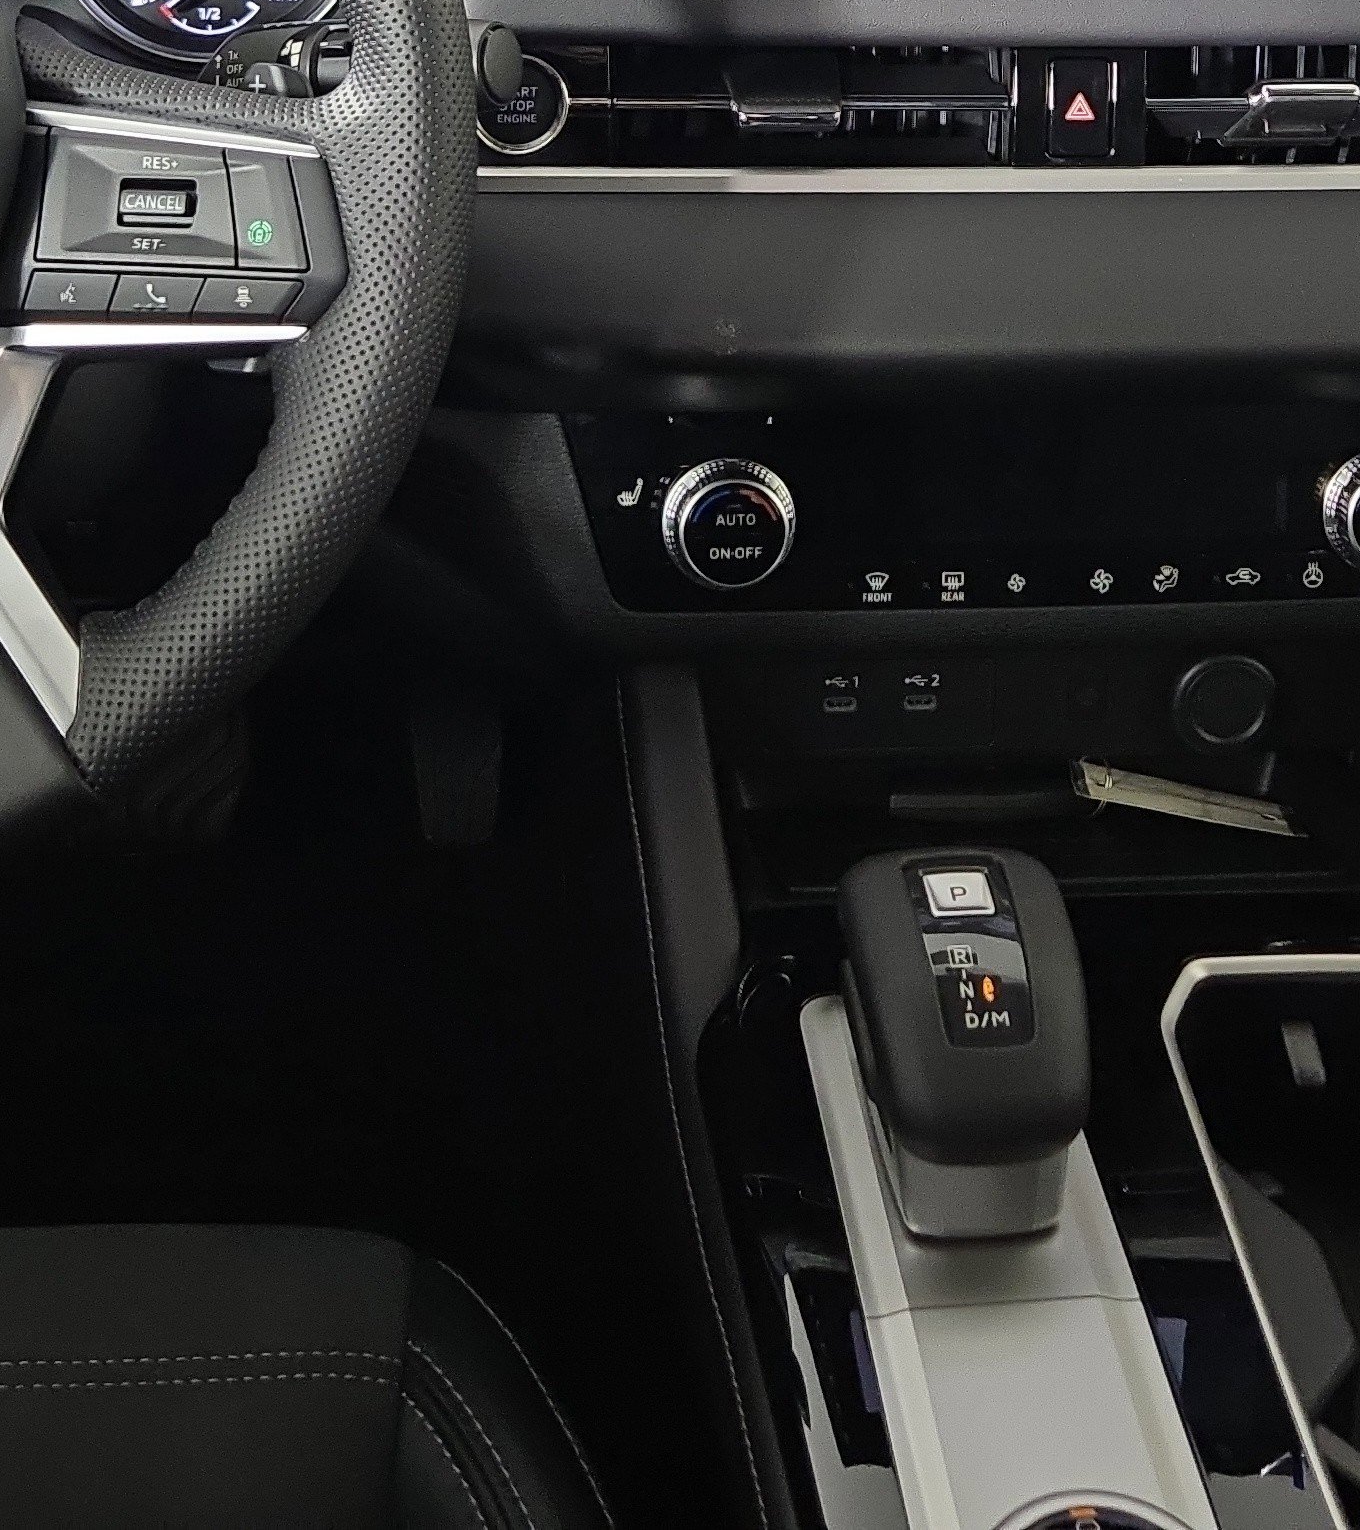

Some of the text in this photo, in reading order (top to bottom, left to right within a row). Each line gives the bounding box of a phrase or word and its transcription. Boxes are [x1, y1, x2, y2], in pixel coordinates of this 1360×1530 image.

[198, 8, 220, 20] 1/2
[227, 64, 243, 74] OFF
[226, 78, 244, 87] AUT
[497, 114, 538, 123] ENGINE
[143, 157, 179, 170] RES+
[125, 195, 184, 210] CANCEL
[132, 238, 167, 250] SET-
[716, 514, 756, 526] AUTO
[862, 592, 892, 602] FRONT
[941, 592, 964, 602] REAR
[852, 676, 858, 688] 1
[931, 674, 939, 686] 2
[950, 886, 967, 901] P
[954, 949, 968, 963] R
[959, 981, 974, 998] N
[965, 1011, 1010, 1028] D/M
